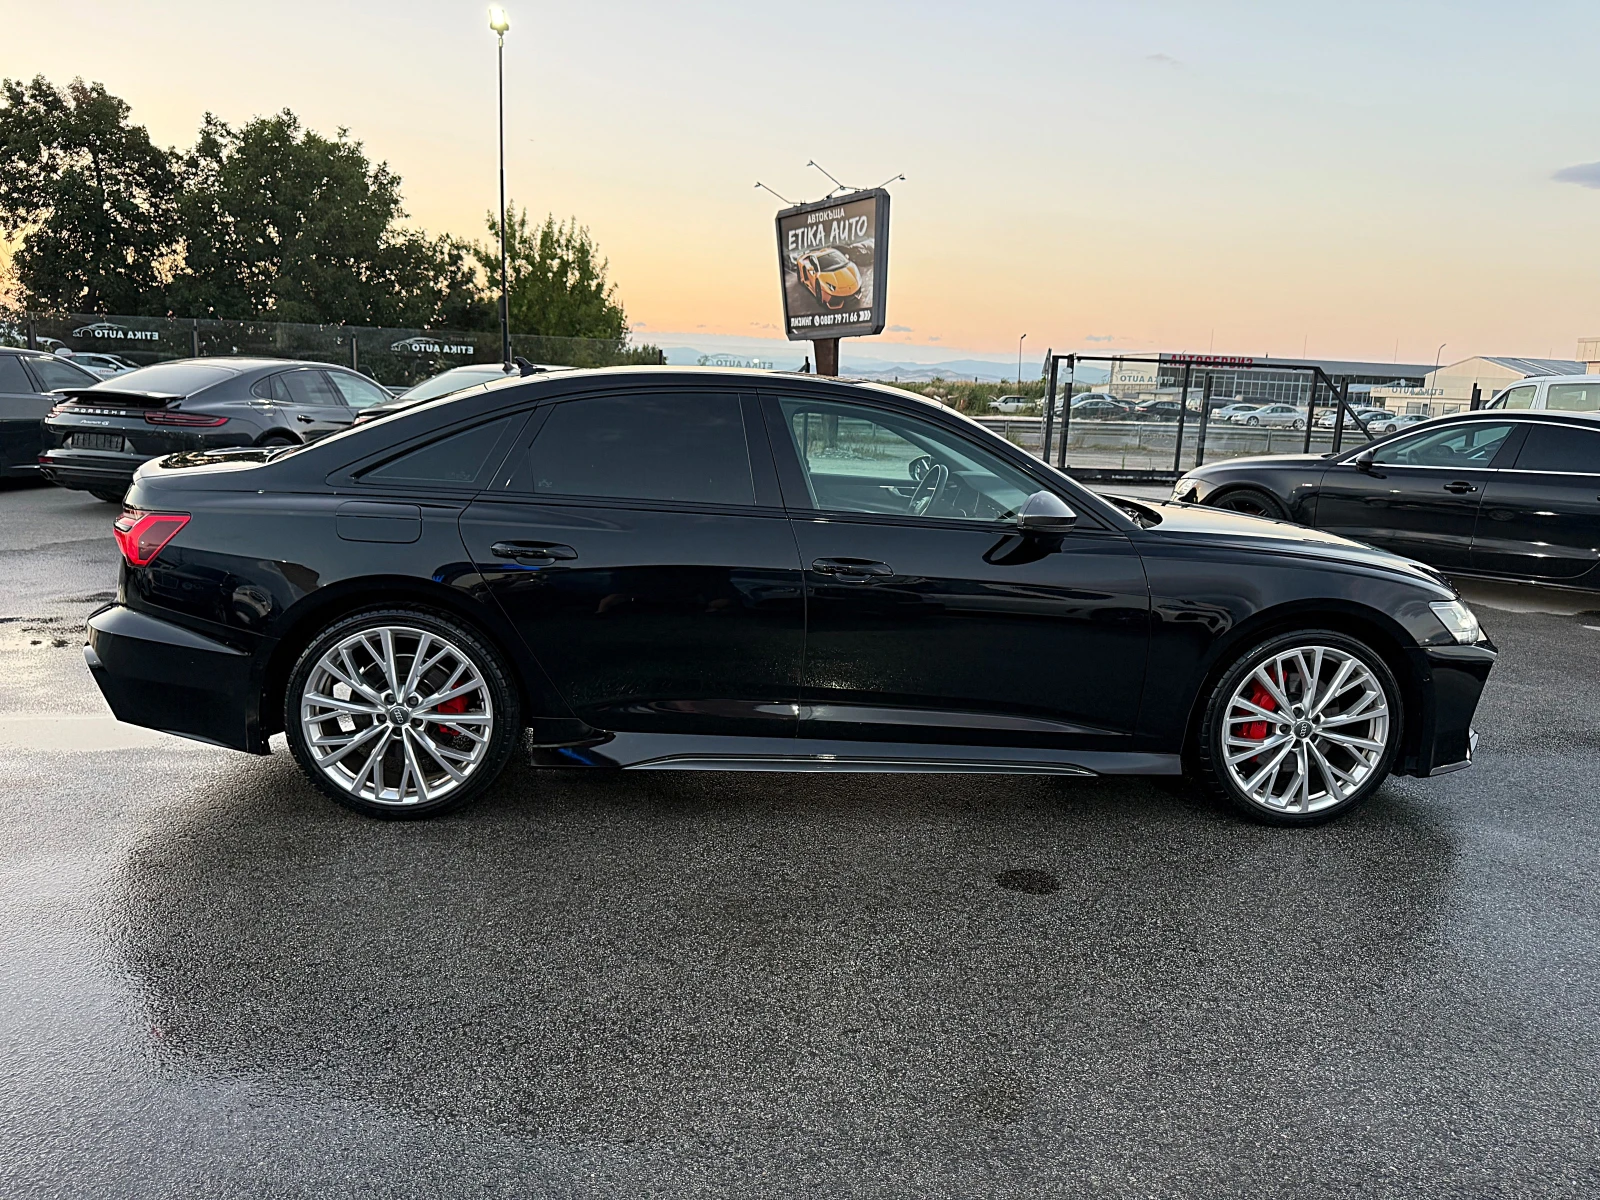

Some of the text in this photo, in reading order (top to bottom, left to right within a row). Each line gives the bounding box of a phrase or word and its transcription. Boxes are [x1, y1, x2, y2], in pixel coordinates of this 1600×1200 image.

[807, 207, 845, 224] АВТОКЪЩА
[788, 215, 868, 250] ETIKA AUTO
[849, 311, 858, 322] 66
[74, 407, 127, 416] PORSCHE
